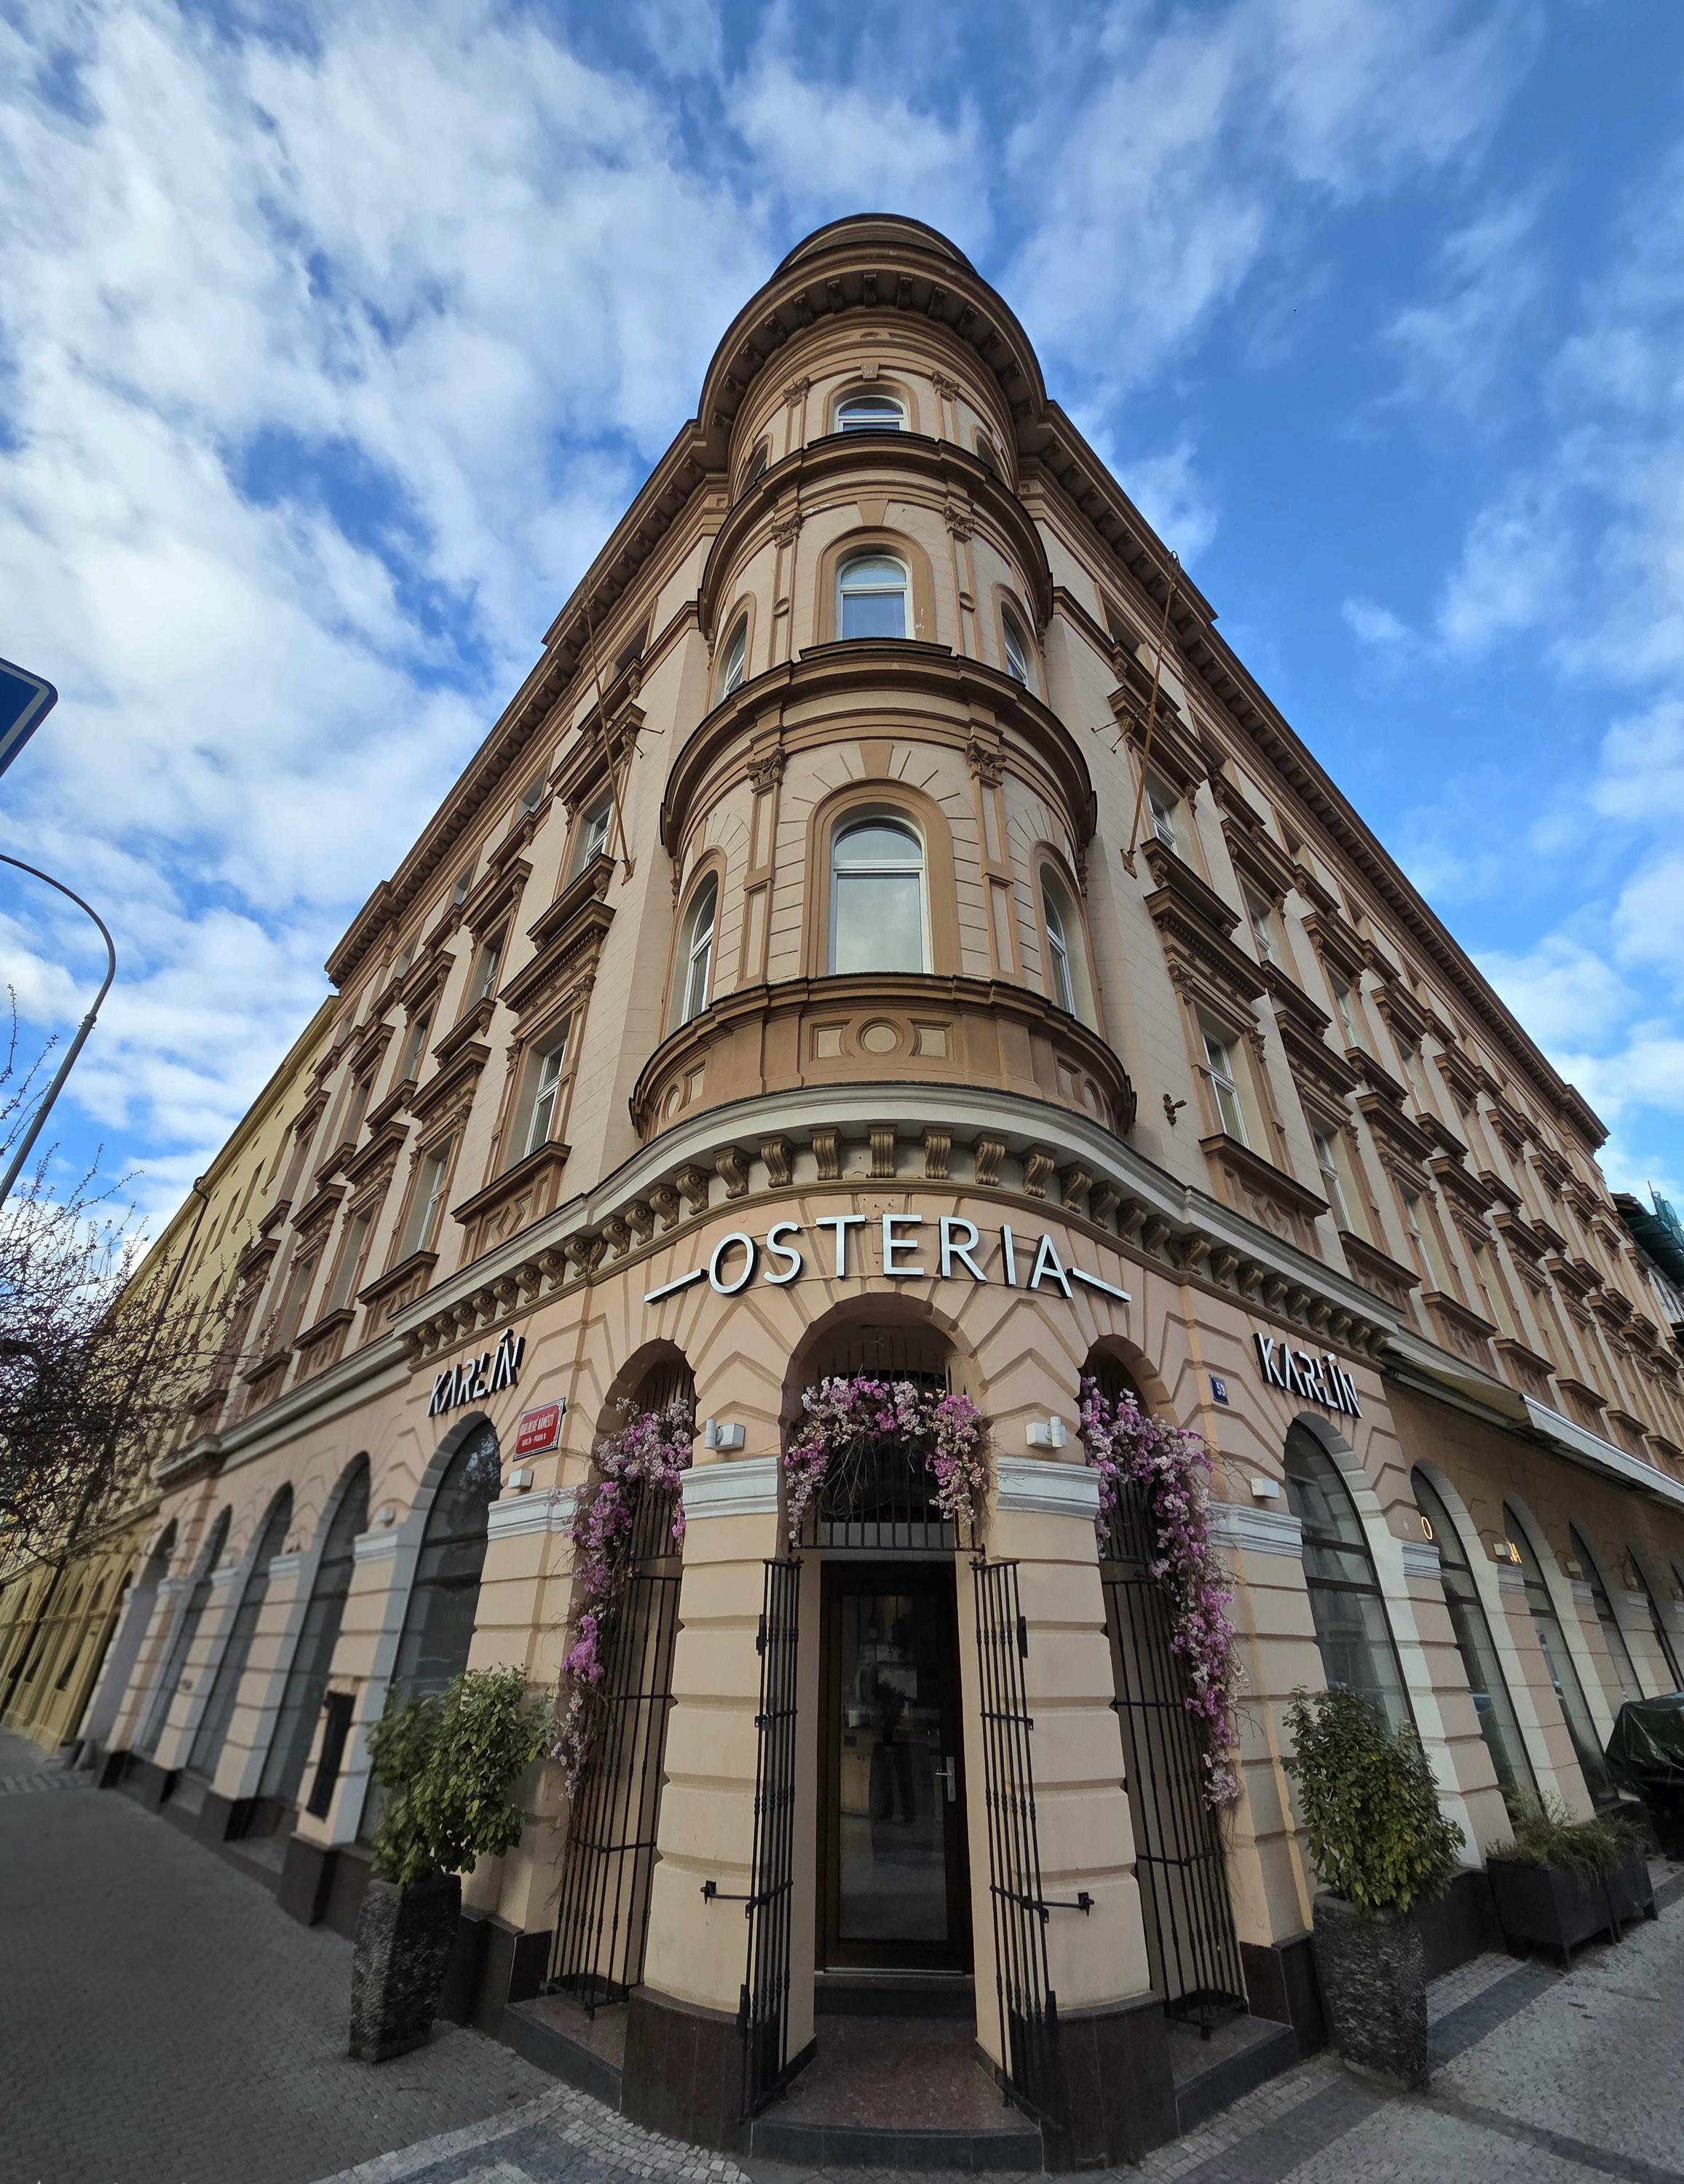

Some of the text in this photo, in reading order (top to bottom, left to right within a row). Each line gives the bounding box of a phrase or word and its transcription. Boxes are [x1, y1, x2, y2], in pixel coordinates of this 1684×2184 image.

[709, 1214, 1072, 1299] OSTERIA
[427, 1329, 526, 1417] KARLÍN
[1216, 1382, 1226, 1397] 53
[1253, 1332, 1363, 1418] KARLÍN
